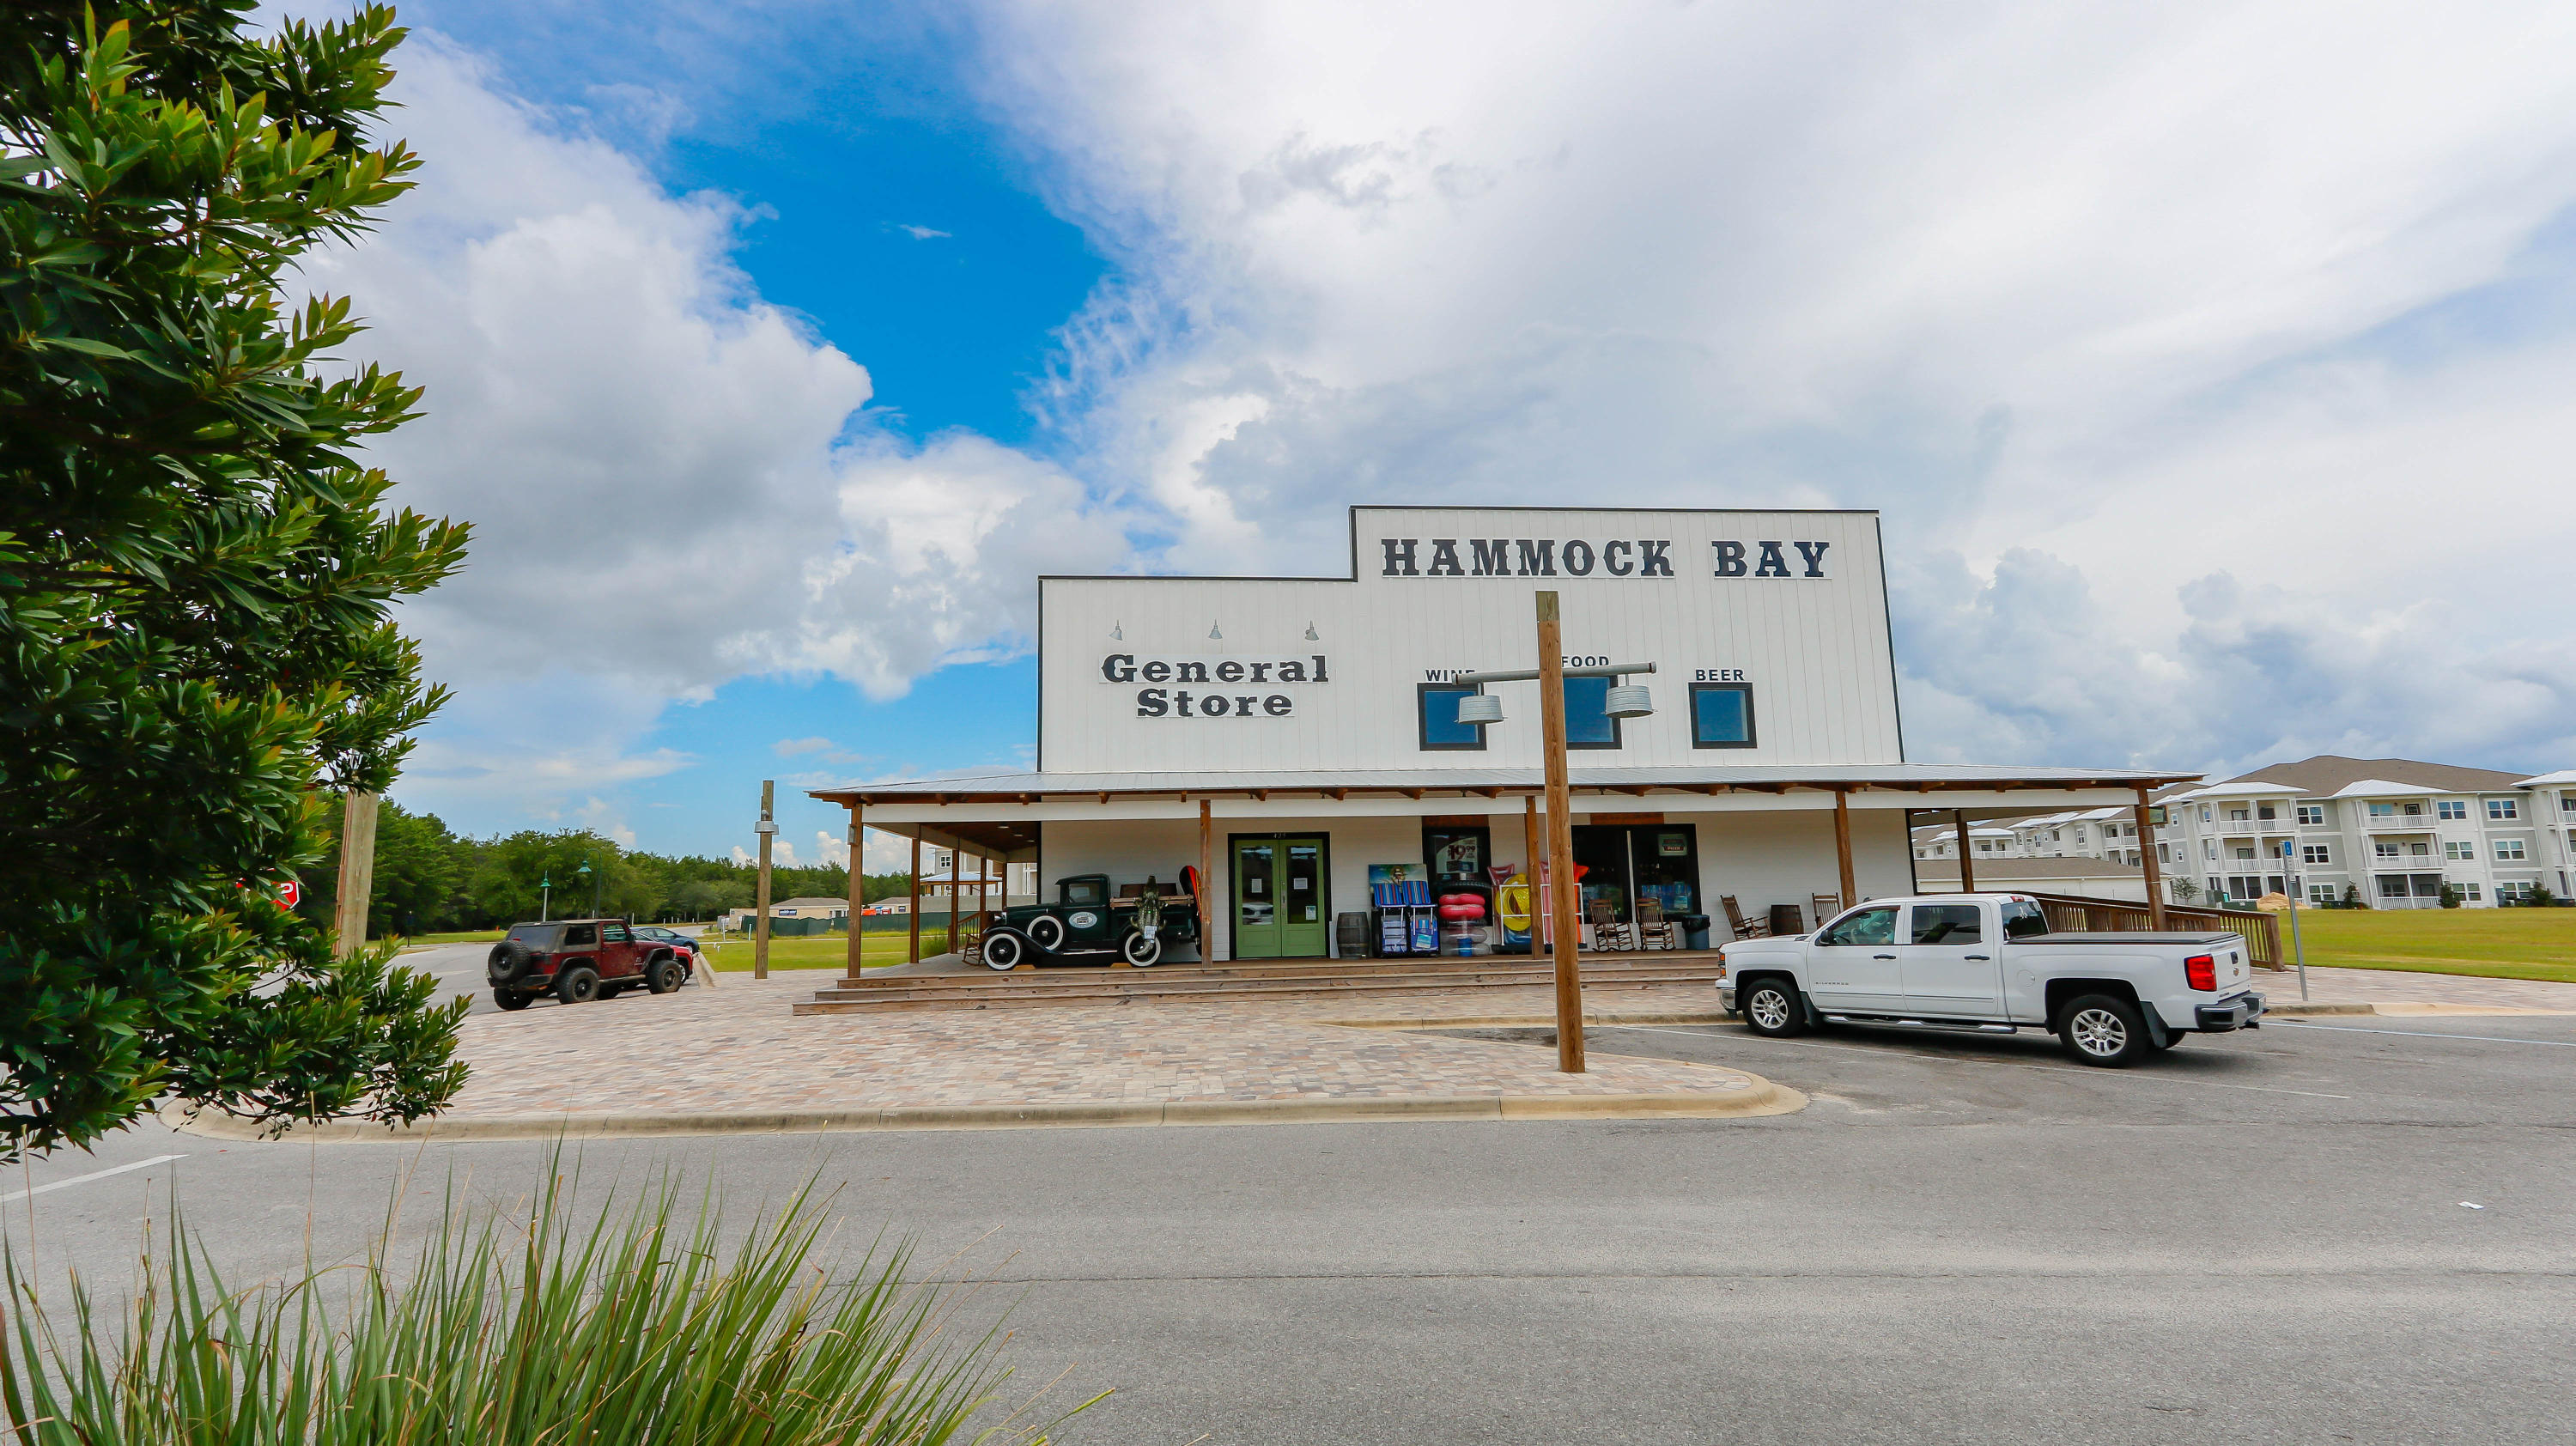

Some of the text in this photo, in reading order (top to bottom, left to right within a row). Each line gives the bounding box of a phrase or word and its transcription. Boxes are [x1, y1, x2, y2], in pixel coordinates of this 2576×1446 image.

[1382, 538, 1830, 578] HAMMOCK BAY
[1101, 653, 1329, 684] General
[1561, 655, 1609, 667] FOOD
[1425, 669, 1475, 682] WI
[1695, 669, 1745, 681] BEER
[1137, 688, 1292, 717] Store
